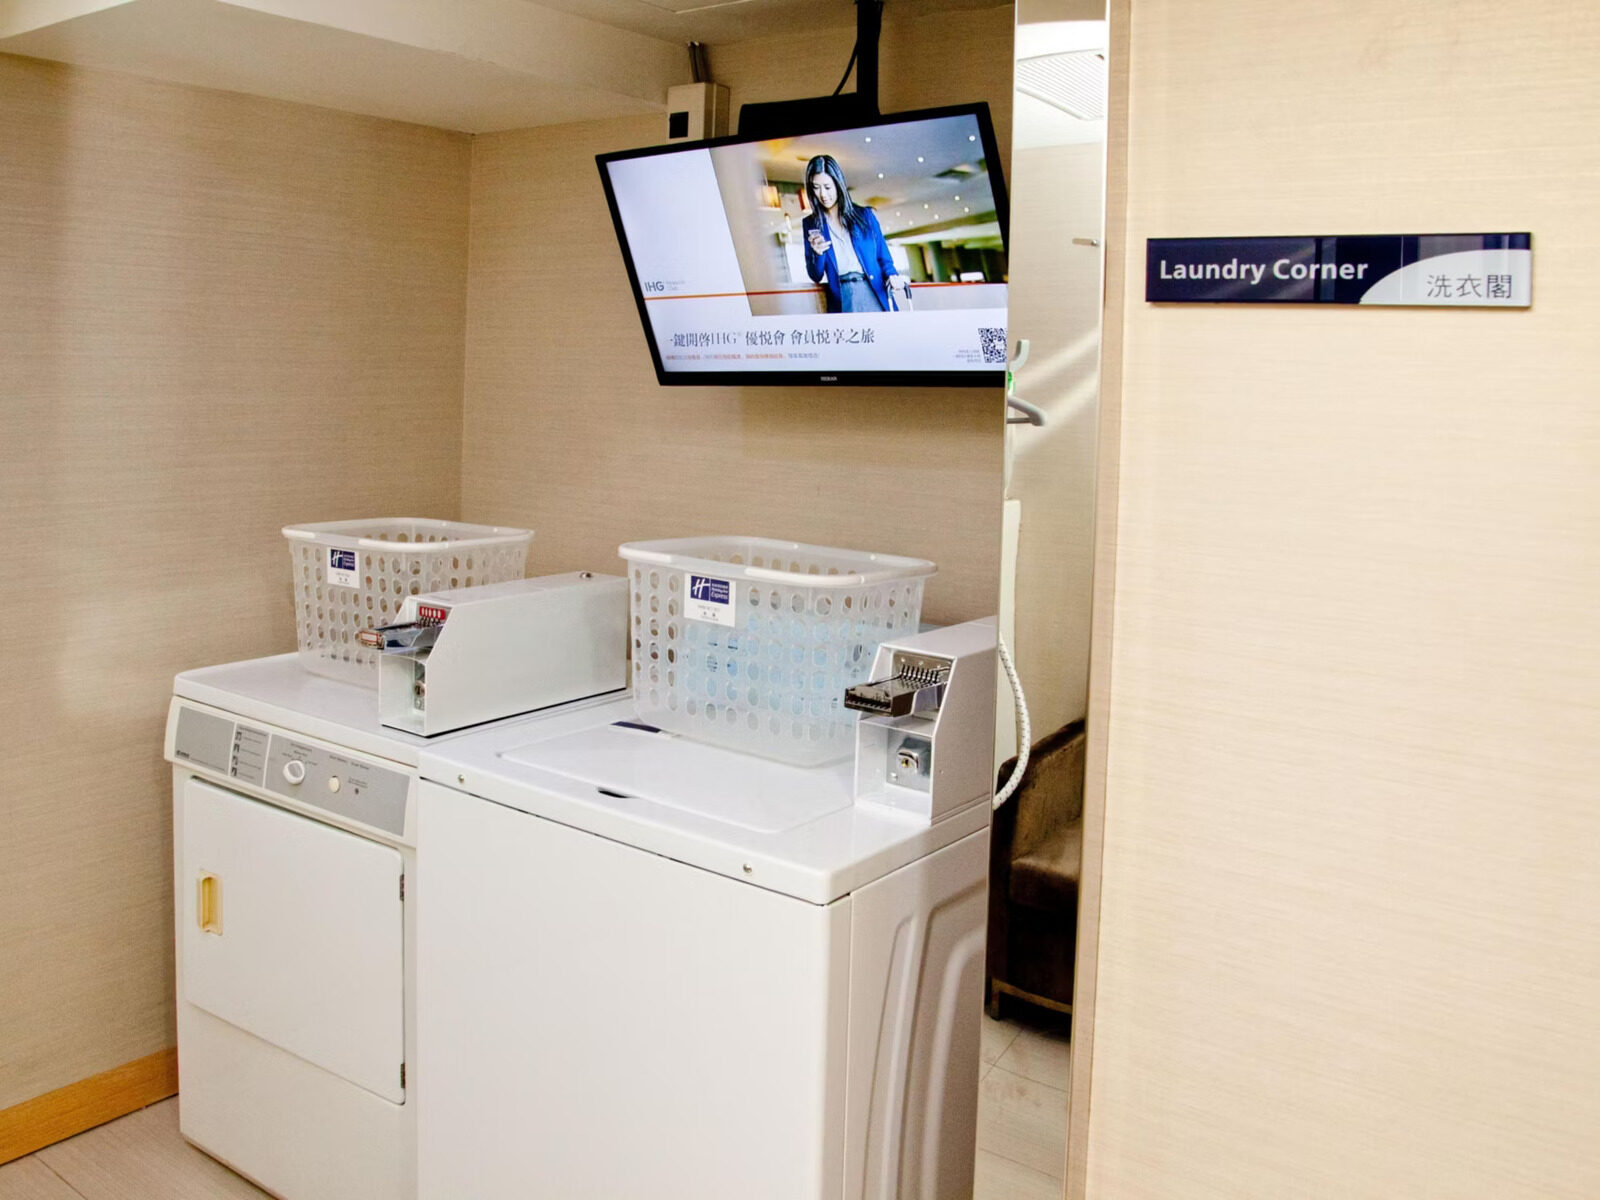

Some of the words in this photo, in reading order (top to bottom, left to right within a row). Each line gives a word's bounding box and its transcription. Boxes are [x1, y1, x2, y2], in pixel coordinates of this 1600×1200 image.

[1160, 258, 1267, 284] Laundry
[1273, 259, 1369, 280] Corner
[644, 281, 665, 293] IHG
[1426, 273, 1512, 298] 洗衣閣
